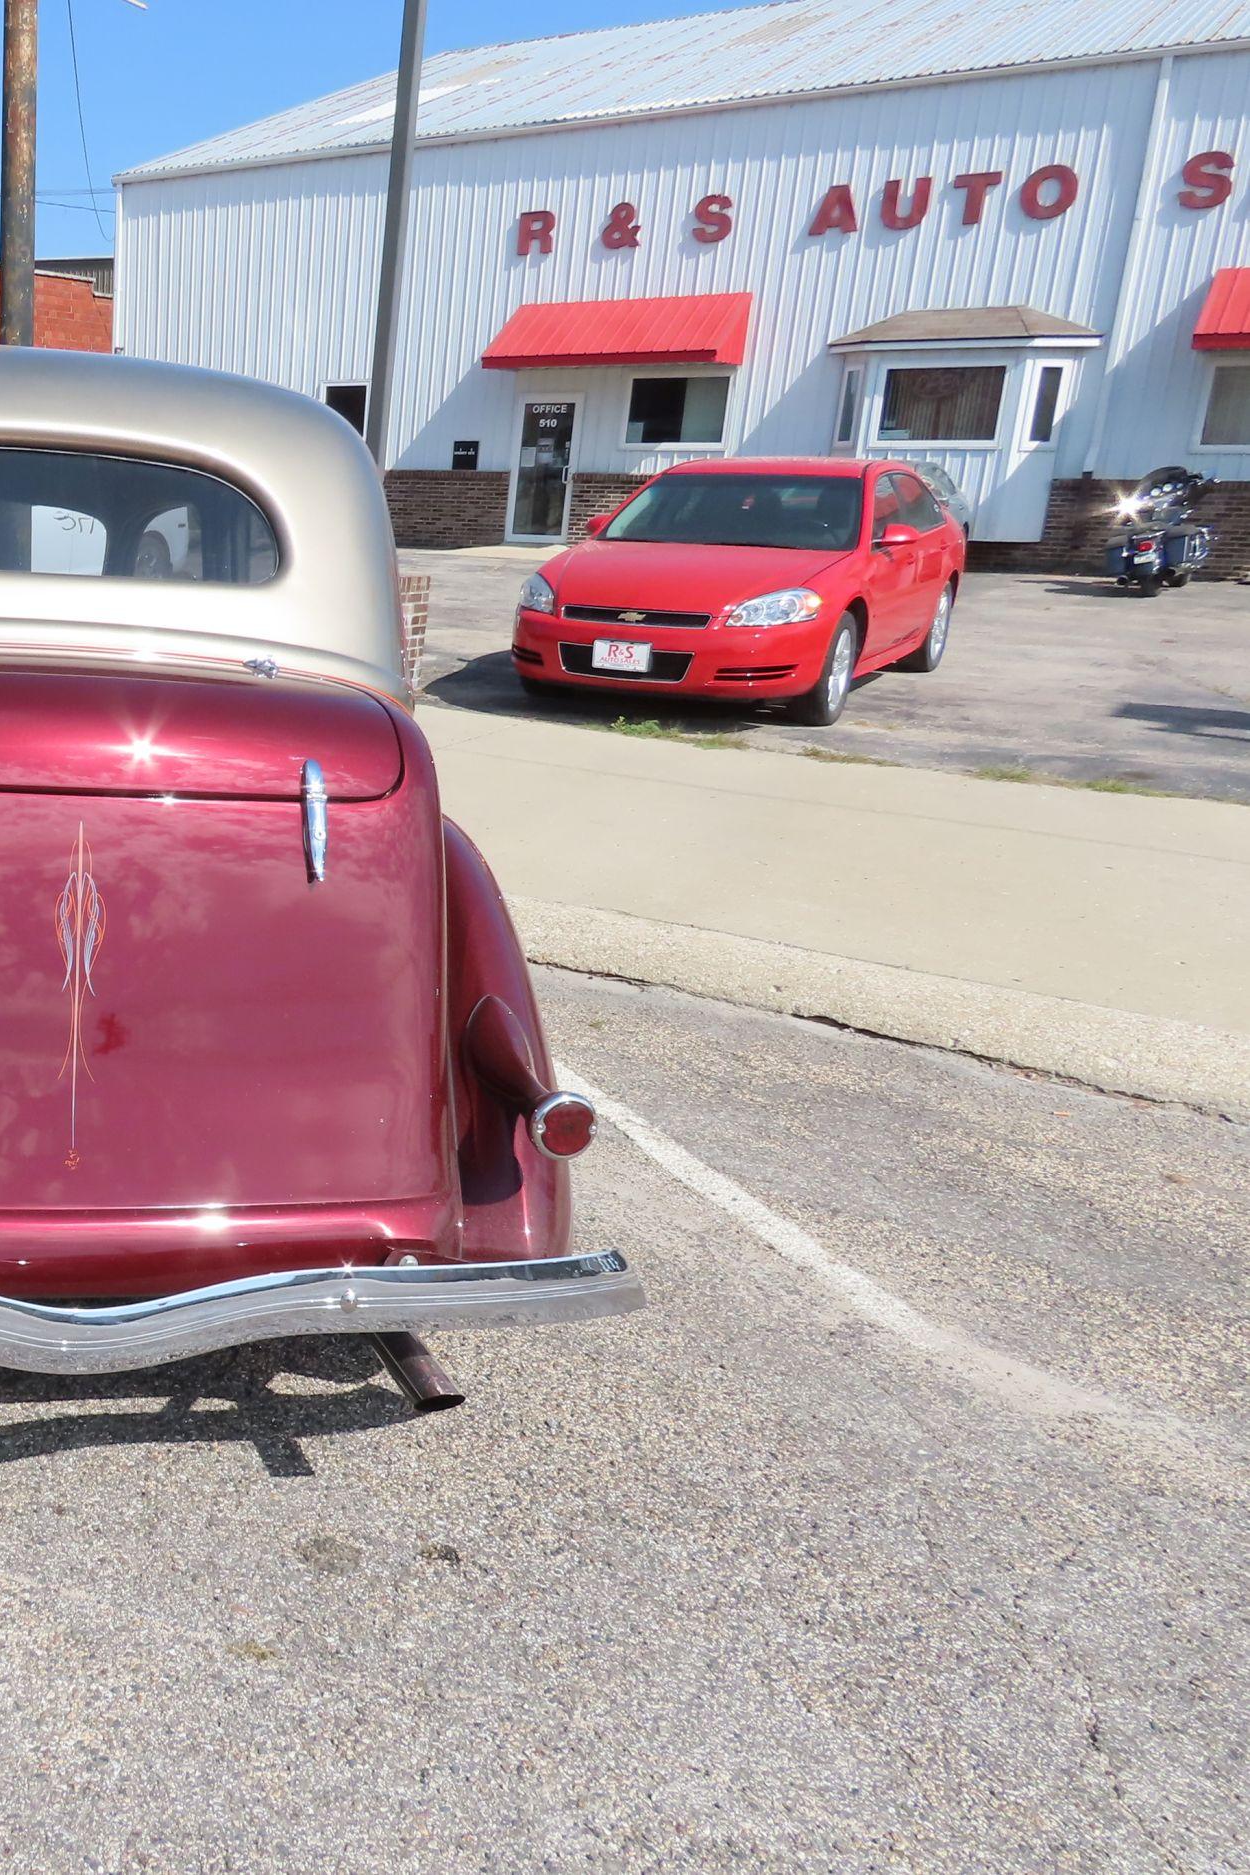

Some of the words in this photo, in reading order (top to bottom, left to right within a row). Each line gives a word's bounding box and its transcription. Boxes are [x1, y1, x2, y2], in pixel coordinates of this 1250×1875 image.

[517, 210, 556, 256] R
[602, 202, 641, 249] &
[692, 194, 733, 244] S
[808, 164, 1079, 237] AUTO
[532, 404, 568, 414] OFFICE
[539, 418, 558, 428] 510
[600, 656, 620, 664] AUTO
